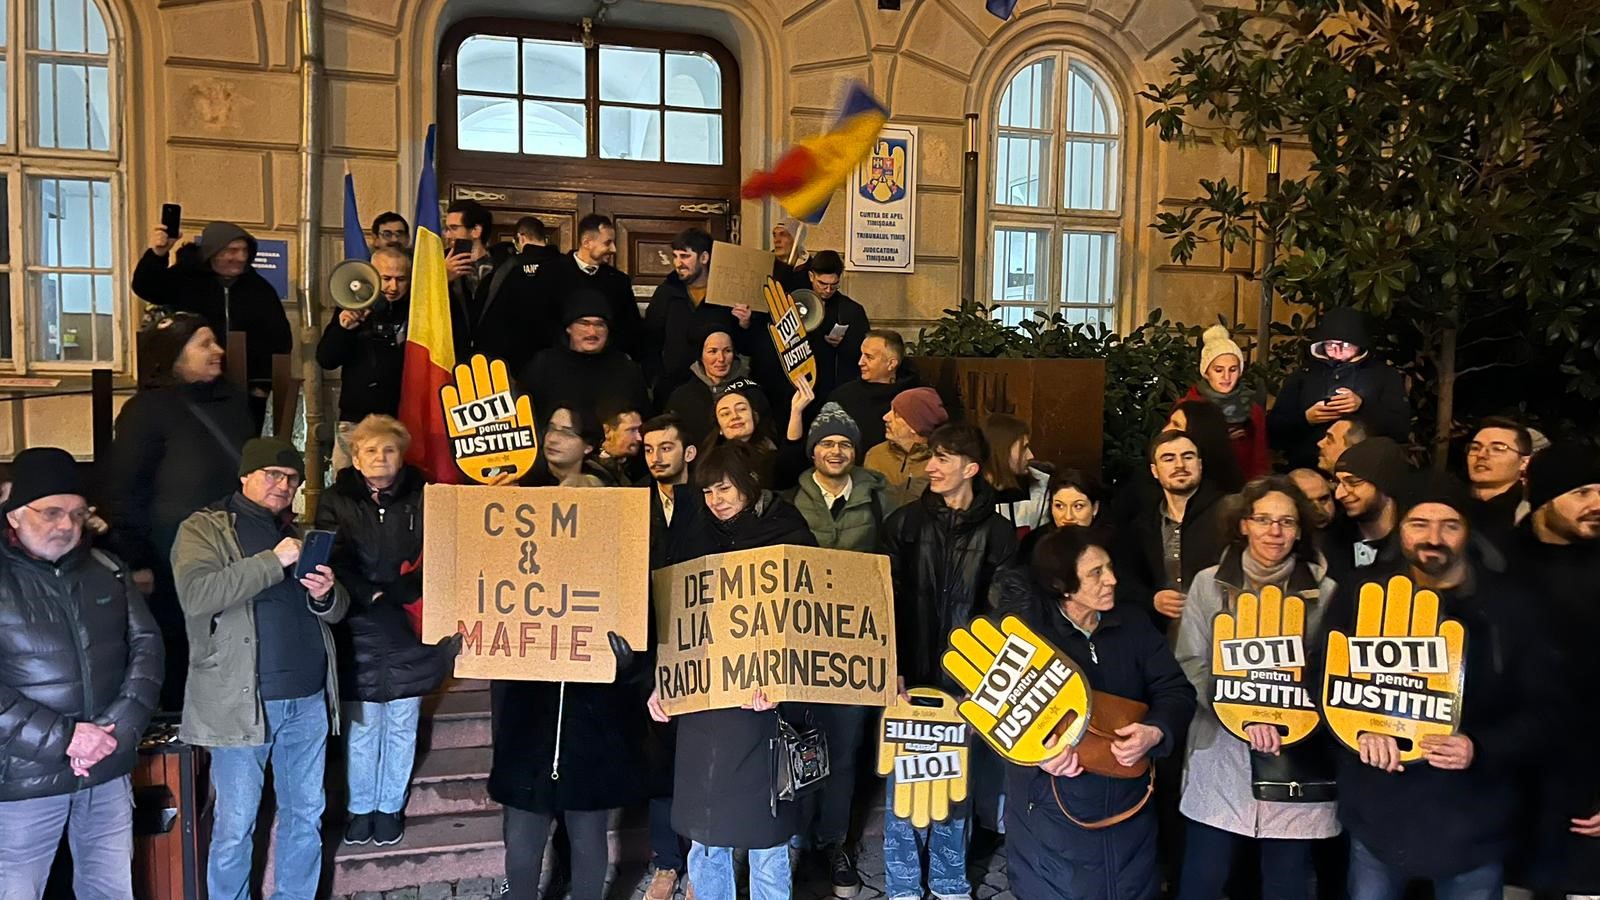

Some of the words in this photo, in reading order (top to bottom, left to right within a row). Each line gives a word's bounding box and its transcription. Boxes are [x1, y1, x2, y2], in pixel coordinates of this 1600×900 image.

[890, 212, 904, 220] APEL
[857, 232, 889, 240] TRIBUNALUL
[479, 422, 509, 436] pentru
[518, 540, 541, 575] &
[677, 611, 714, 651] LIA
[729, 598, 887, 647] SAVONEA,
[457, 620, 593, 662] MAFIE
[1223, 639, 1297, 667] TOȚI
[1351, 640, 1438, 672] TOȚI
[658, 658, 711, 700] RADU
[722, 648, 887, 693] MARINESCU
[1007, 669, 1038, 705] pentru
[1250, 670, 1291, 682] pentru
[1375, 673, 1424, 690] pentru
[1329, 680, 1453, 721] JUSTIȚIE
